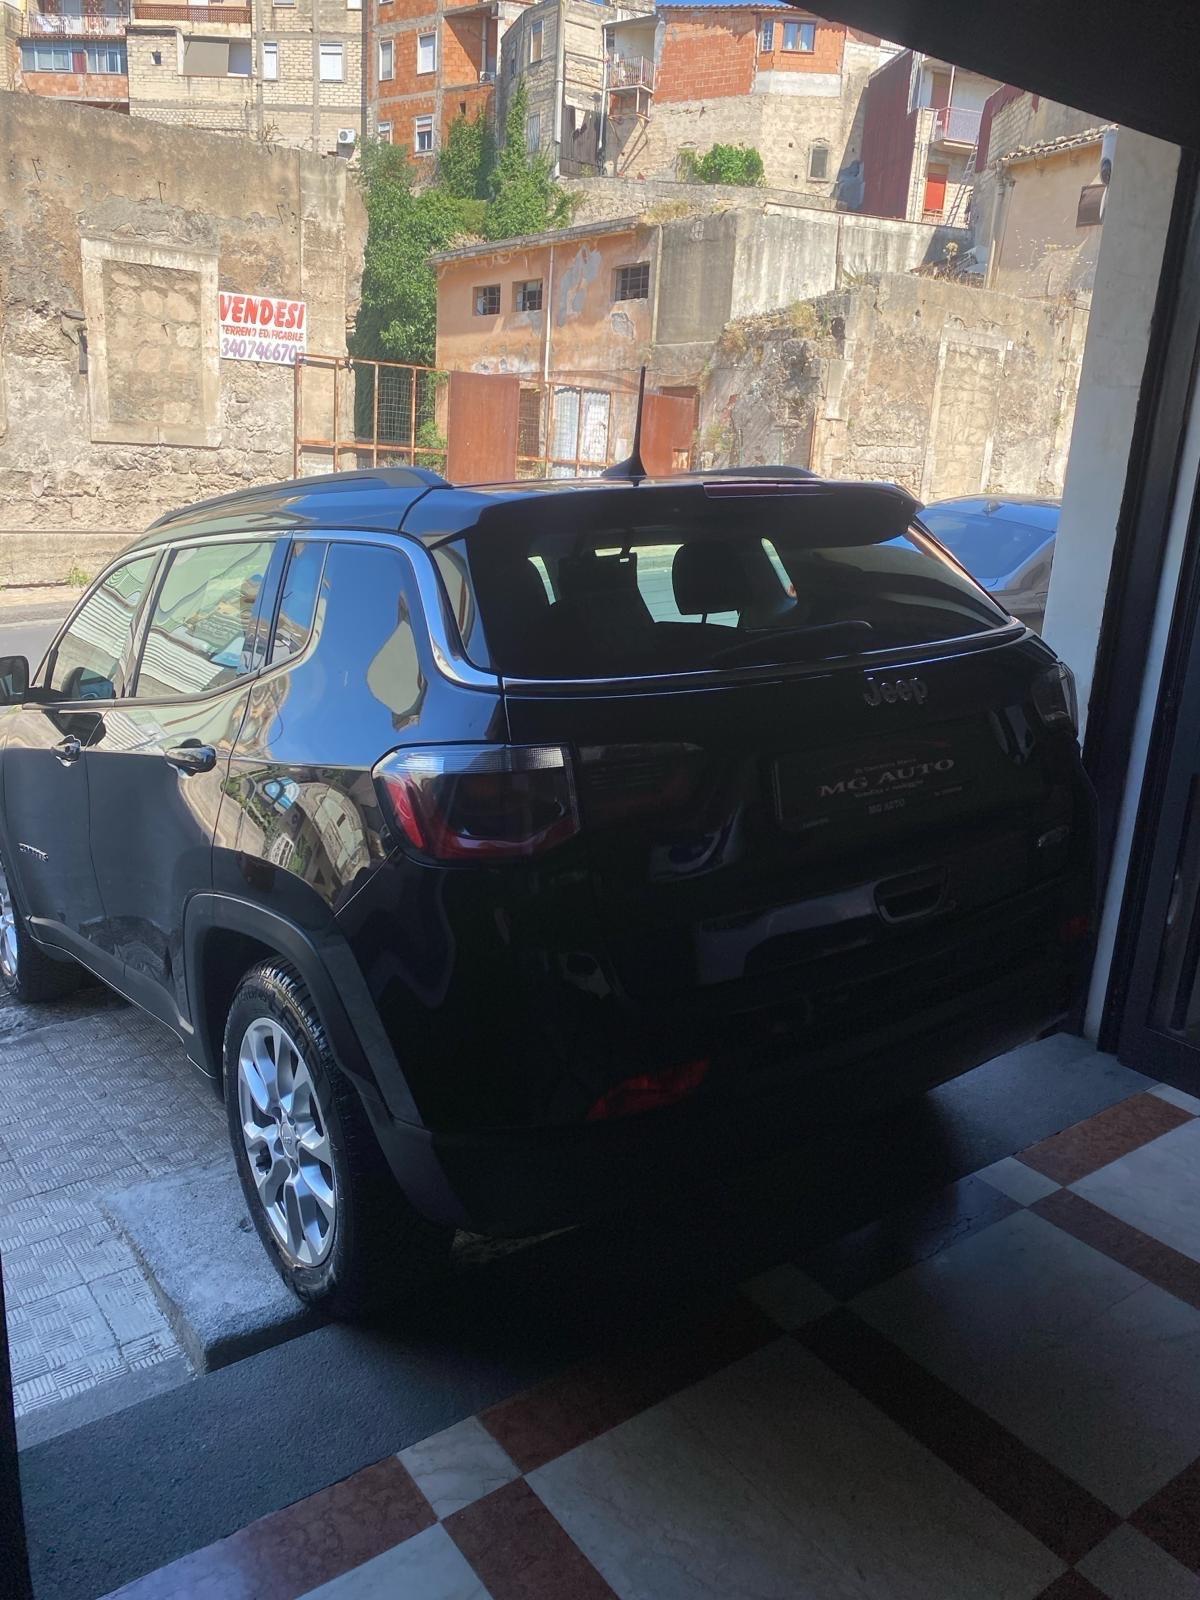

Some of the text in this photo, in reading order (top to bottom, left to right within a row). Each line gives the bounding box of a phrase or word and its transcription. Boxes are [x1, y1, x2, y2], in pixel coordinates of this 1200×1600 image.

[219, 295, 305, 329] VENDESI
[221, 325, 304, 342] TERRENO EDIFICABILE
[864, 677, 927, 707] Jeep
[818, 776, 868, 798] MG
[878, 759, 955, 785] AUTO
